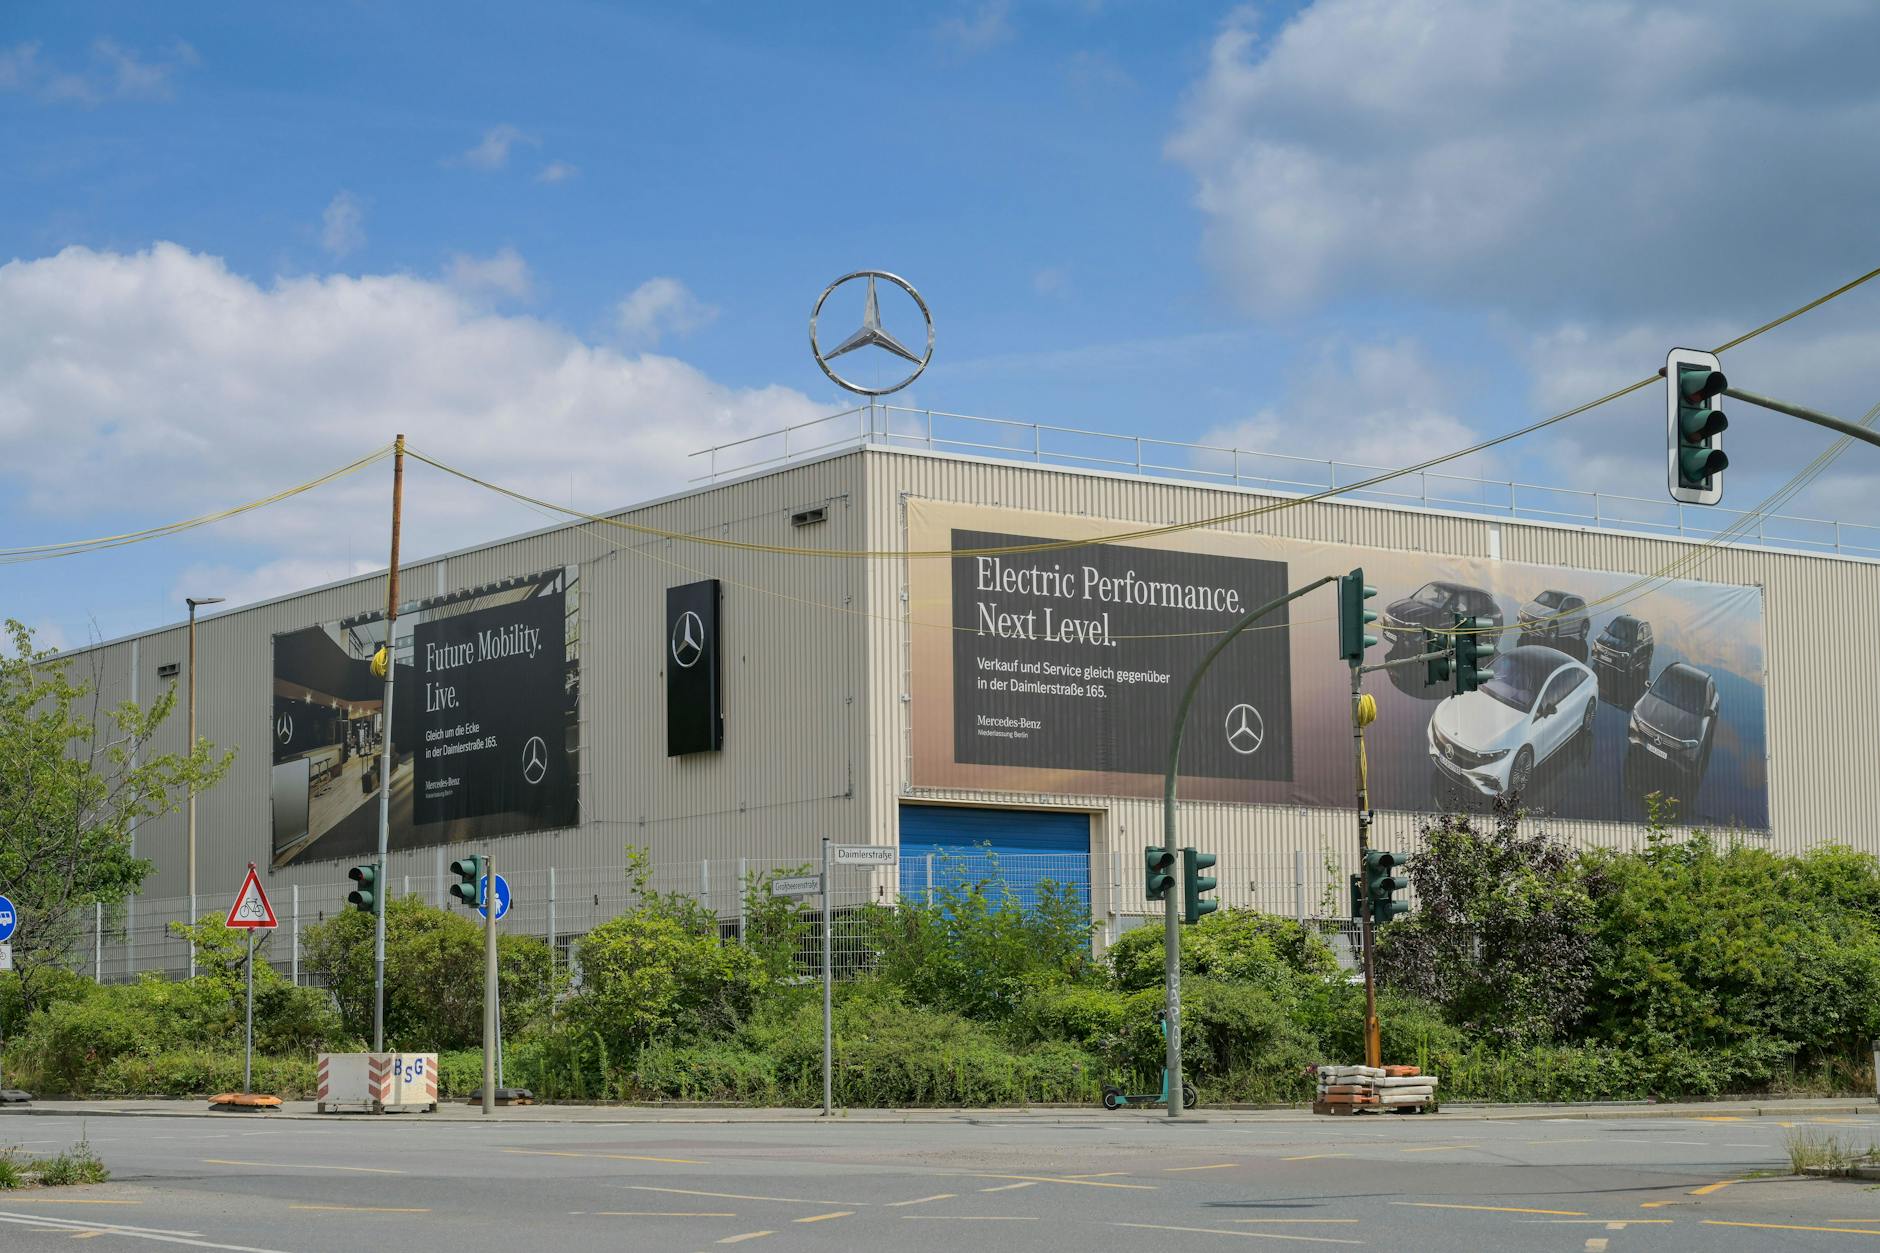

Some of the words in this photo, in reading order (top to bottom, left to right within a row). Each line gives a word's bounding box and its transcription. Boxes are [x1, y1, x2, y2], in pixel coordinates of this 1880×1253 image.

[976, 556, 1075, 599] Electric
[1082, 566, 1246, 614] Performance.
[977, 602, 1037, 640] Next
[1044, 607, 1118, 647] Level.
[426, 642, 475, 673] Future
[477, 623, 542, 662] Mobility.
[976, 656, 1018, 673] Verkauf
[1020, 661, 1041, 674] und
[1043, 662, 1082, 678] Service
[1084, 664, 1115, 681] gleich
[1116, 670, 1171, 684] gegenüber
[426, 682, 459, 712] Live.
[977, 676, 988, 690] in
[989, 677, 1008, 691] der
[1010, 678, 1084, 697] Daimlerstraße
[1085, 684, 1108, 698] 165.
[425, 729, 444, 742] Gleich
[444, 728, 455, 739] um
[455, 725, 465, 737] die
[465, 722, 480, 735] Ecke
[976, 714, 1042, 730] Mercedes-Benz
[425, 748, 432, 759] in
[432, 746, 443, 758] der
[443, 738, 485, 756] Daimlerstraße
[485, 735, 498, 749] 165.
[838, 849, 893, 861] Daimlerstraße
